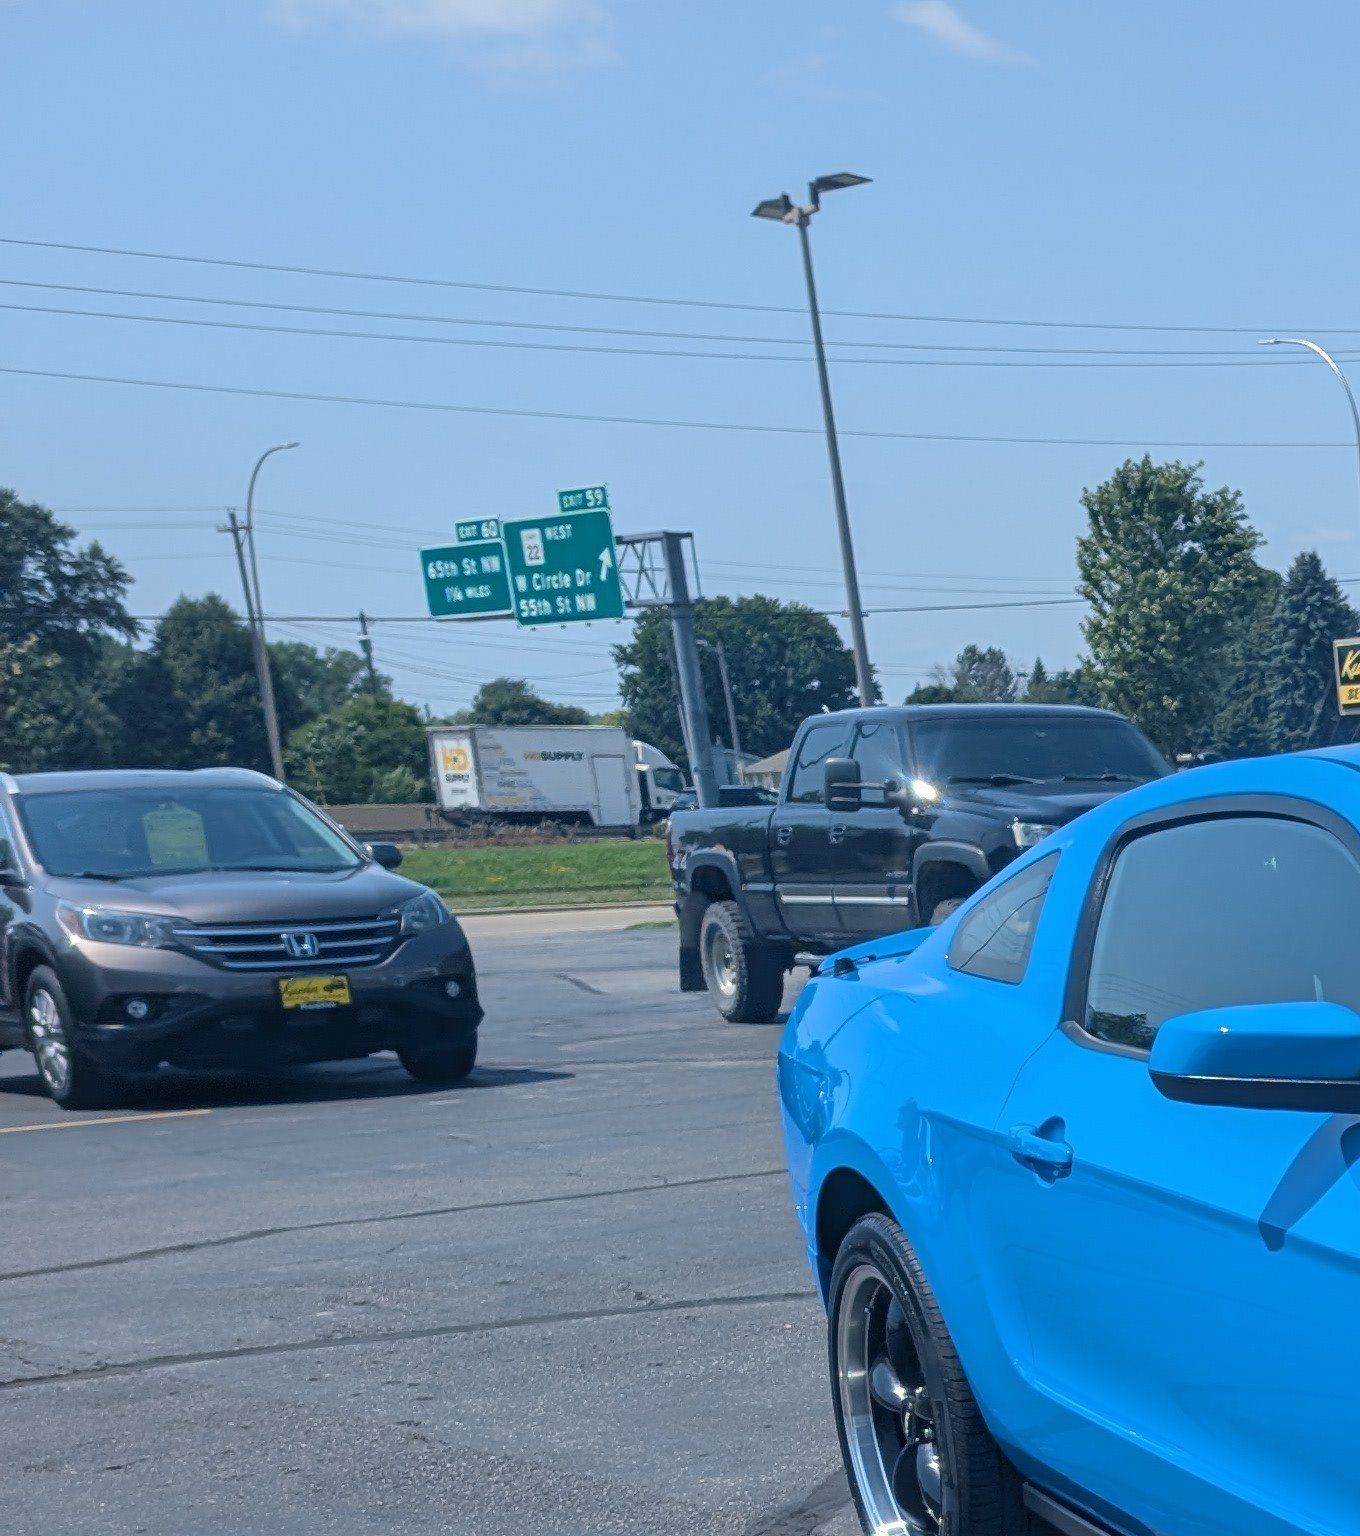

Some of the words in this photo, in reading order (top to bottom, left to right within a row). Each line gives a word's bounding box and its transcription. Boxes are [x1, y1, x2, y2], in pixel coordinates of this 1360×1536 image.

[545, 524, 572, 541] WEST
[526, 544, 541, 560] 22
[461, 557, 477, 577] St
[480, 556, 500, 573] NW
[531, 570, 572, 592] Circle
[575, 568, 592, 587] Dr
[519, 598, 552, 618] 55th
[555, 595, 572, 614] St
[575, 592, 597, 613] NW
